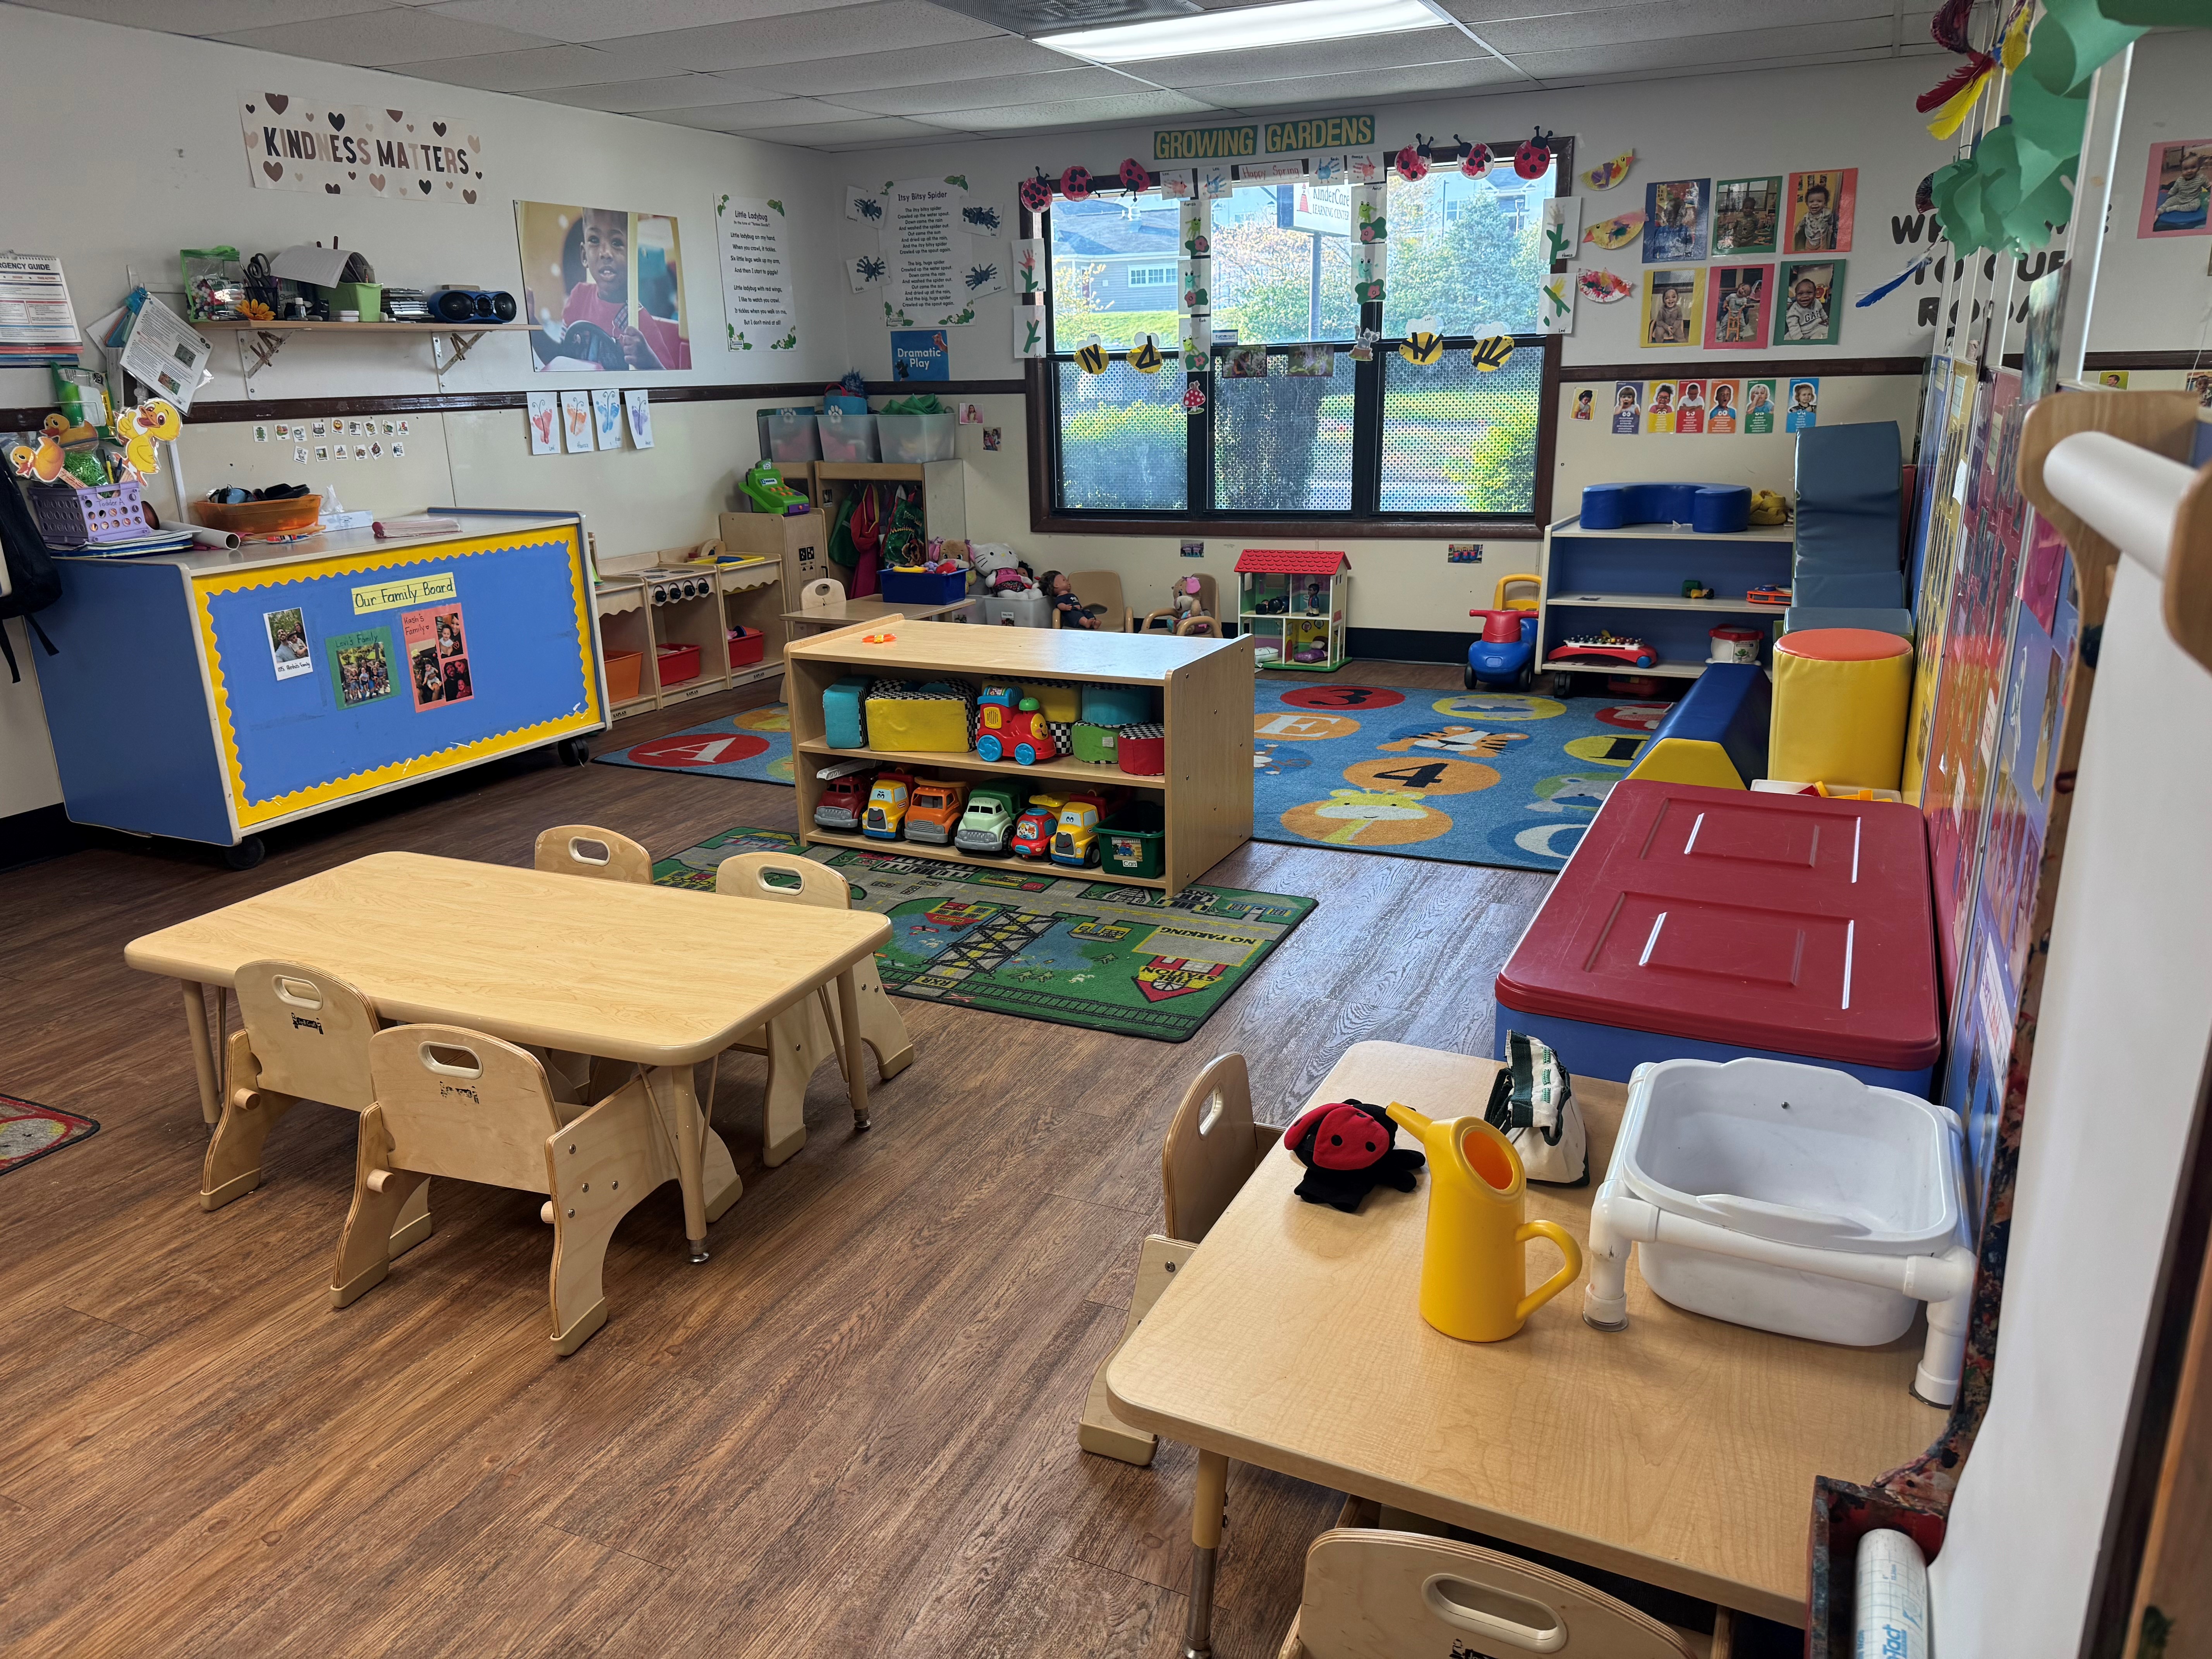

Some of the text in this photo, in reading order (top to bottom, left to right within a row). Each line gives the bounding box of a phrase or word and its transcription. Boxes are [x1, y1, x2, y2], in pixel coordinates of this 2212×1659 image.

[1155, 117, 1372, 158] GROWING GARDENS
[263, 127, 469, 174] KINDNESS MATTERS
[1242, 165, 1300, 180] Happy Spring
[928, 191, 947, 200] Spider
[748, 212, 768, 222] Ladybug
[1313, 204, 1350, 220] LEARNING CENTER
[897, 348, 941, 358] Dramatic
[910, 357, 929, 370] Play
[355, 578, 453, 608] Our Family Board
[404, 613, 424, 625] Kash's
[405, 624, 425, 635] Family
[335, 632, 378, 648] Levi's Family
[1308, 689, 1373, 706] 3
[1254, 714, 1341, 737] E
[639, 737, 736, 763] A
[1372, 763, 1449, 788] 4
[1160, 927, 1257, 945] NO PARKING
[918, 977, 950, 986] RXR
[1142, 967, 1218, 982] STATION
